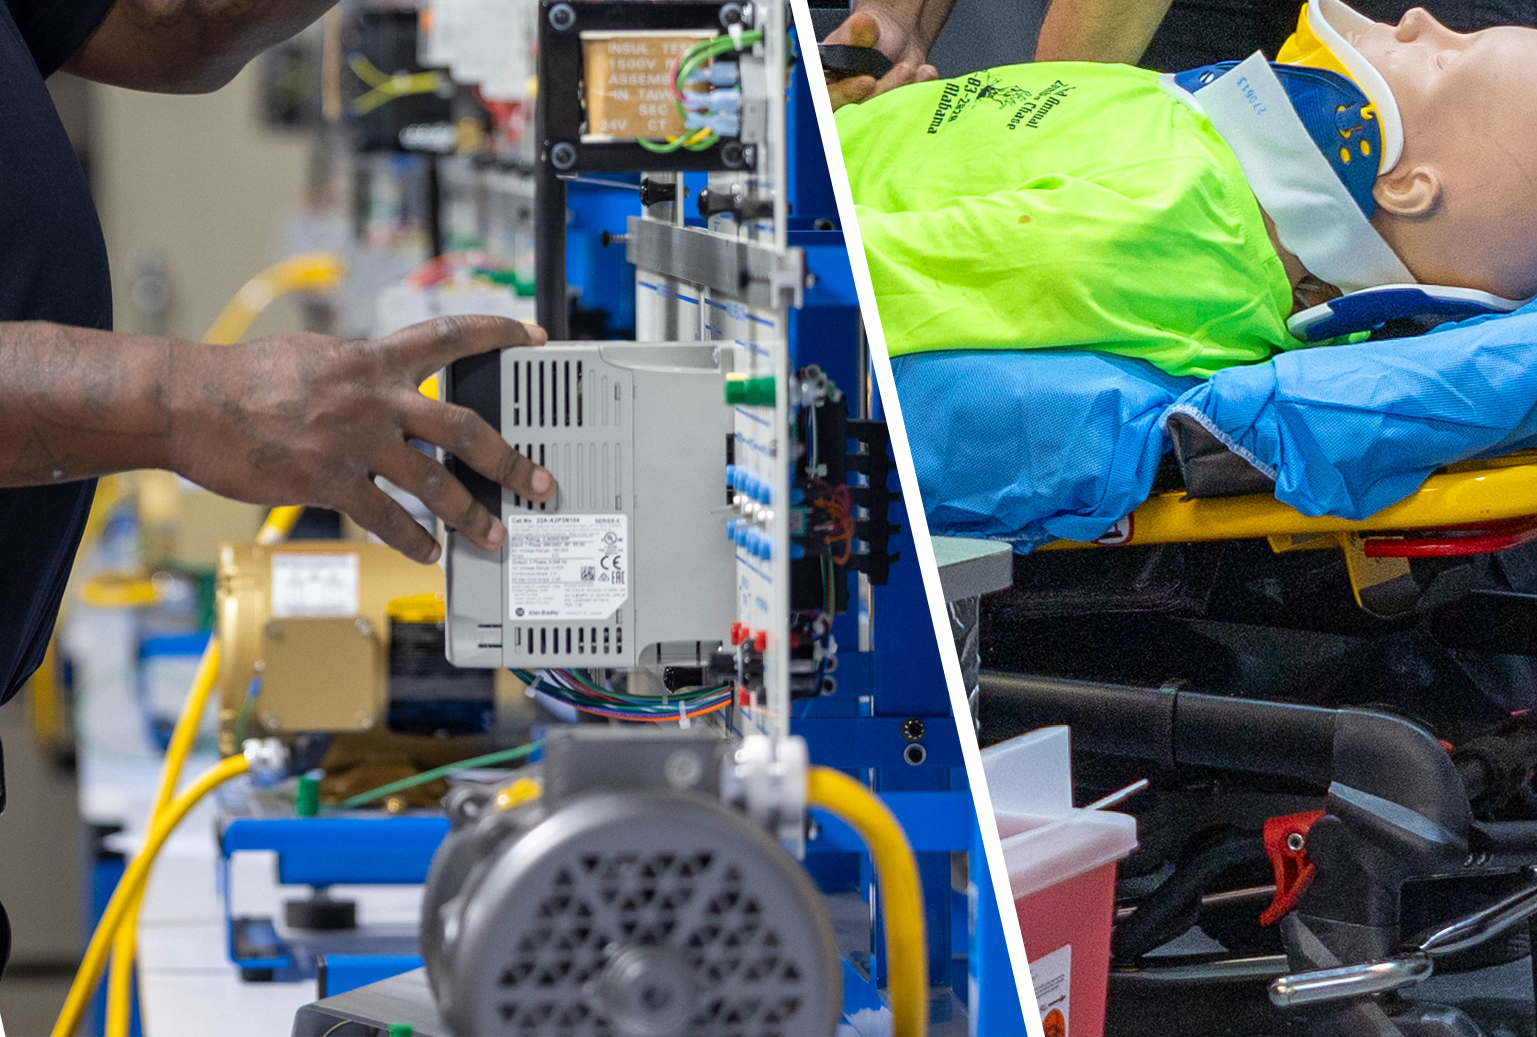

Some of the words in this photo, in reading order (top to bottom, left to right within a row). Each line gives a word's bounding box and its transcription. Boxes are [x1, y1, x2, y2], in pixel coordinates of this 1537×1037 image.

[662, 43, 695, 55] TES
[608, 72, 671, 85] ASSEMB
[638, 88, 675, 101] TAIW
[927, 82, 959, 134] Alabama
[1237, 76, 1267, 115] 270613
[1006, 102, 1037, 130] Chase
[1025, 96, 1060, 129] Annual
